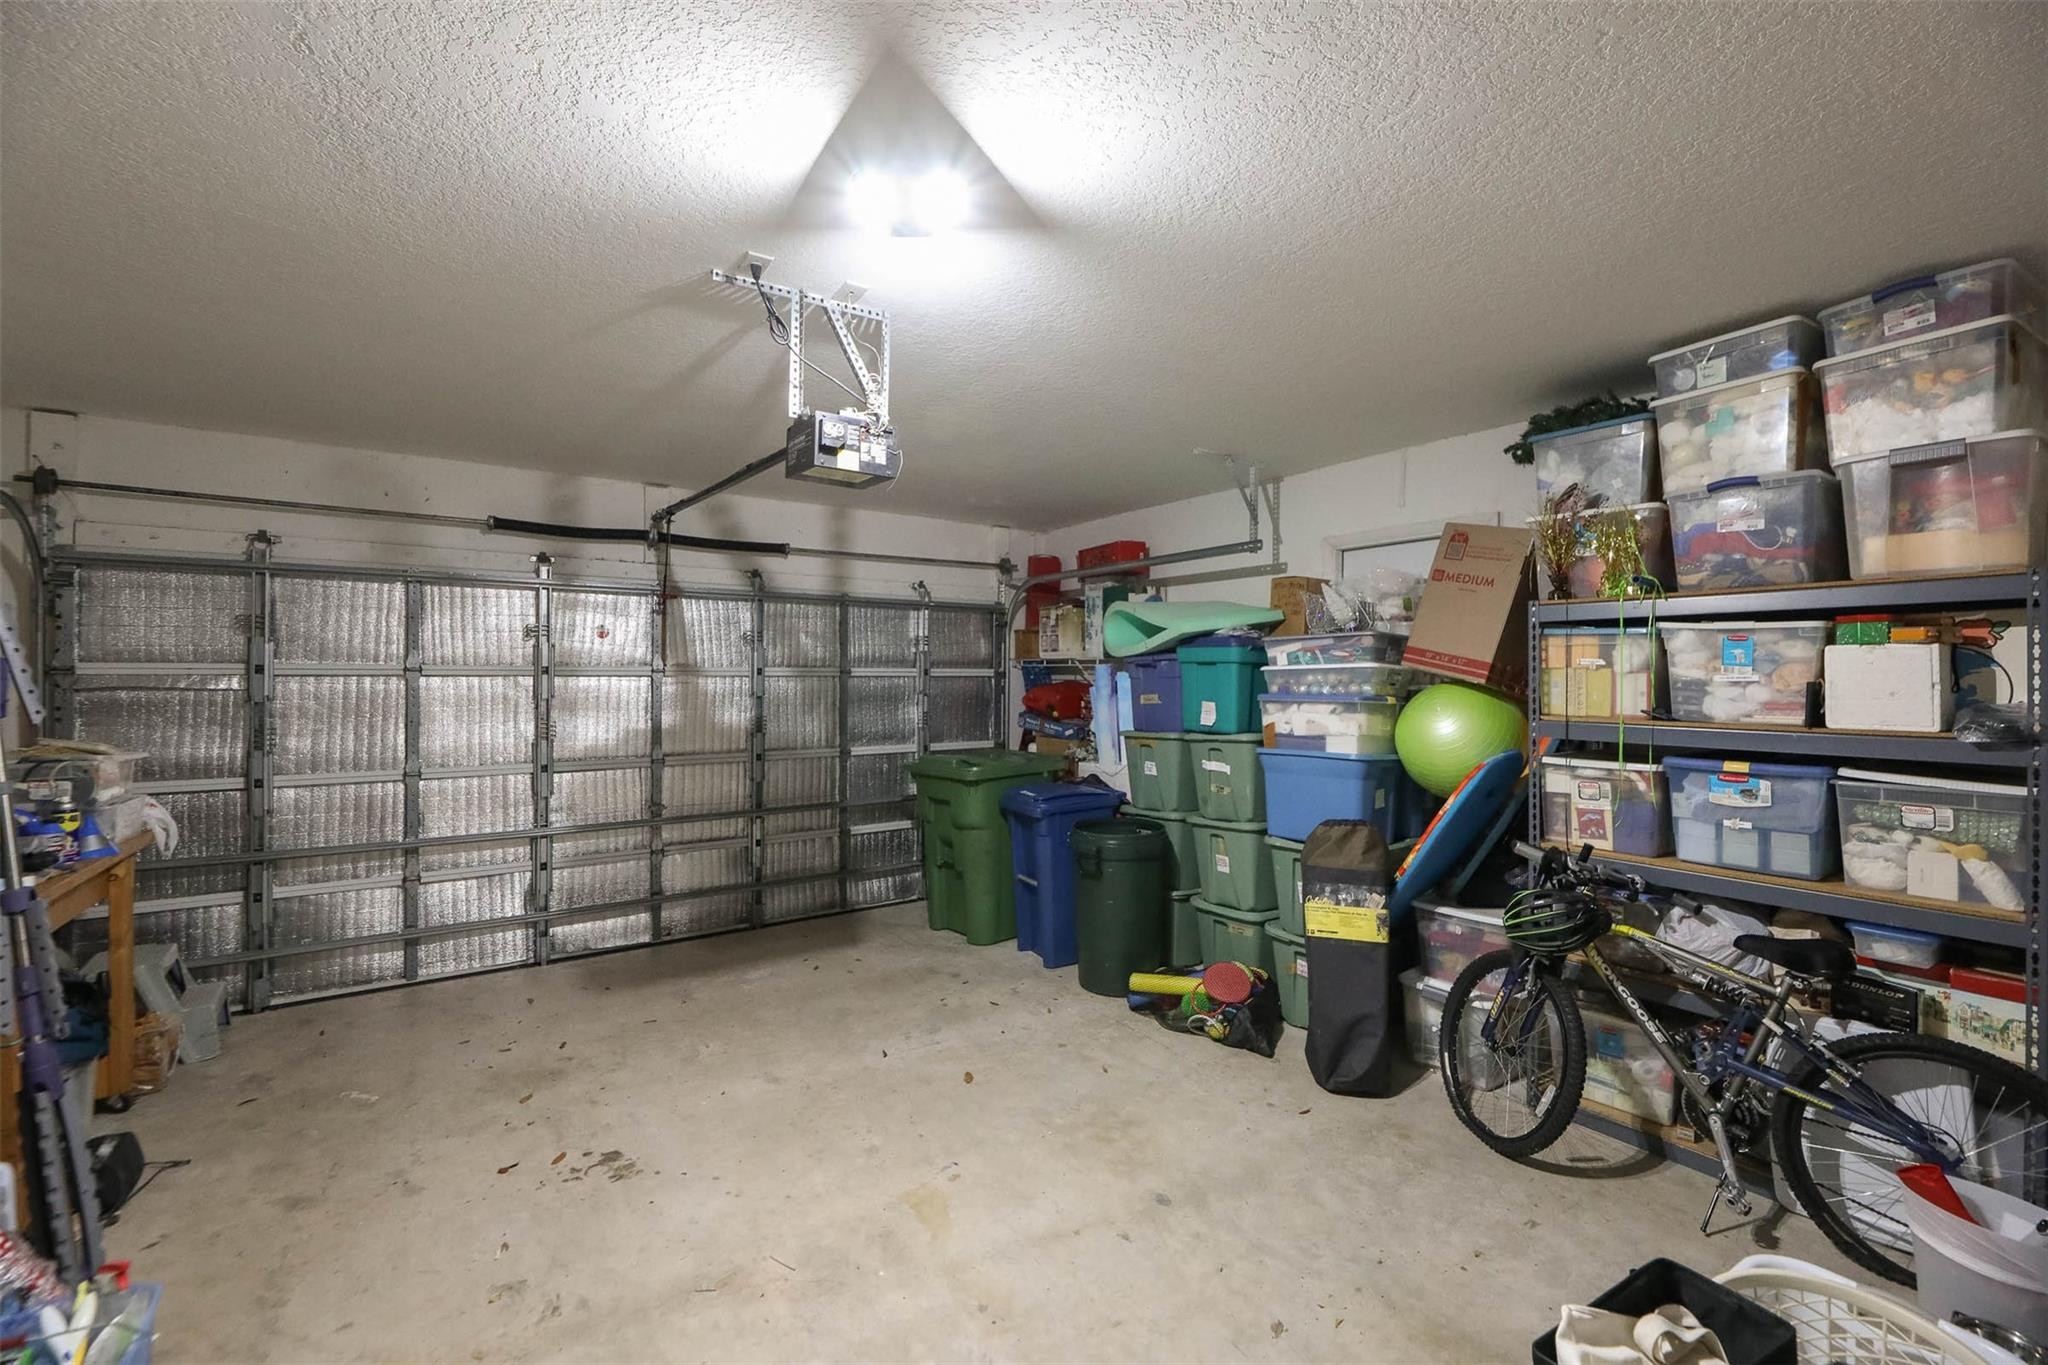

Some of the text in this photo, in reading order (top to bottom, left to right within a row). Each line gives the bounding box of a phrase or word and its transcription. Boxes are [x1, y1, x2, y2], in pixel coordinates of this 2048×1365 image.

[1444, 572, 1495, 588] MEDIUM
[1586, 945, 1667, 1043] MONGOOSE
[1850, 981, 1905, 998] DUNLOP
